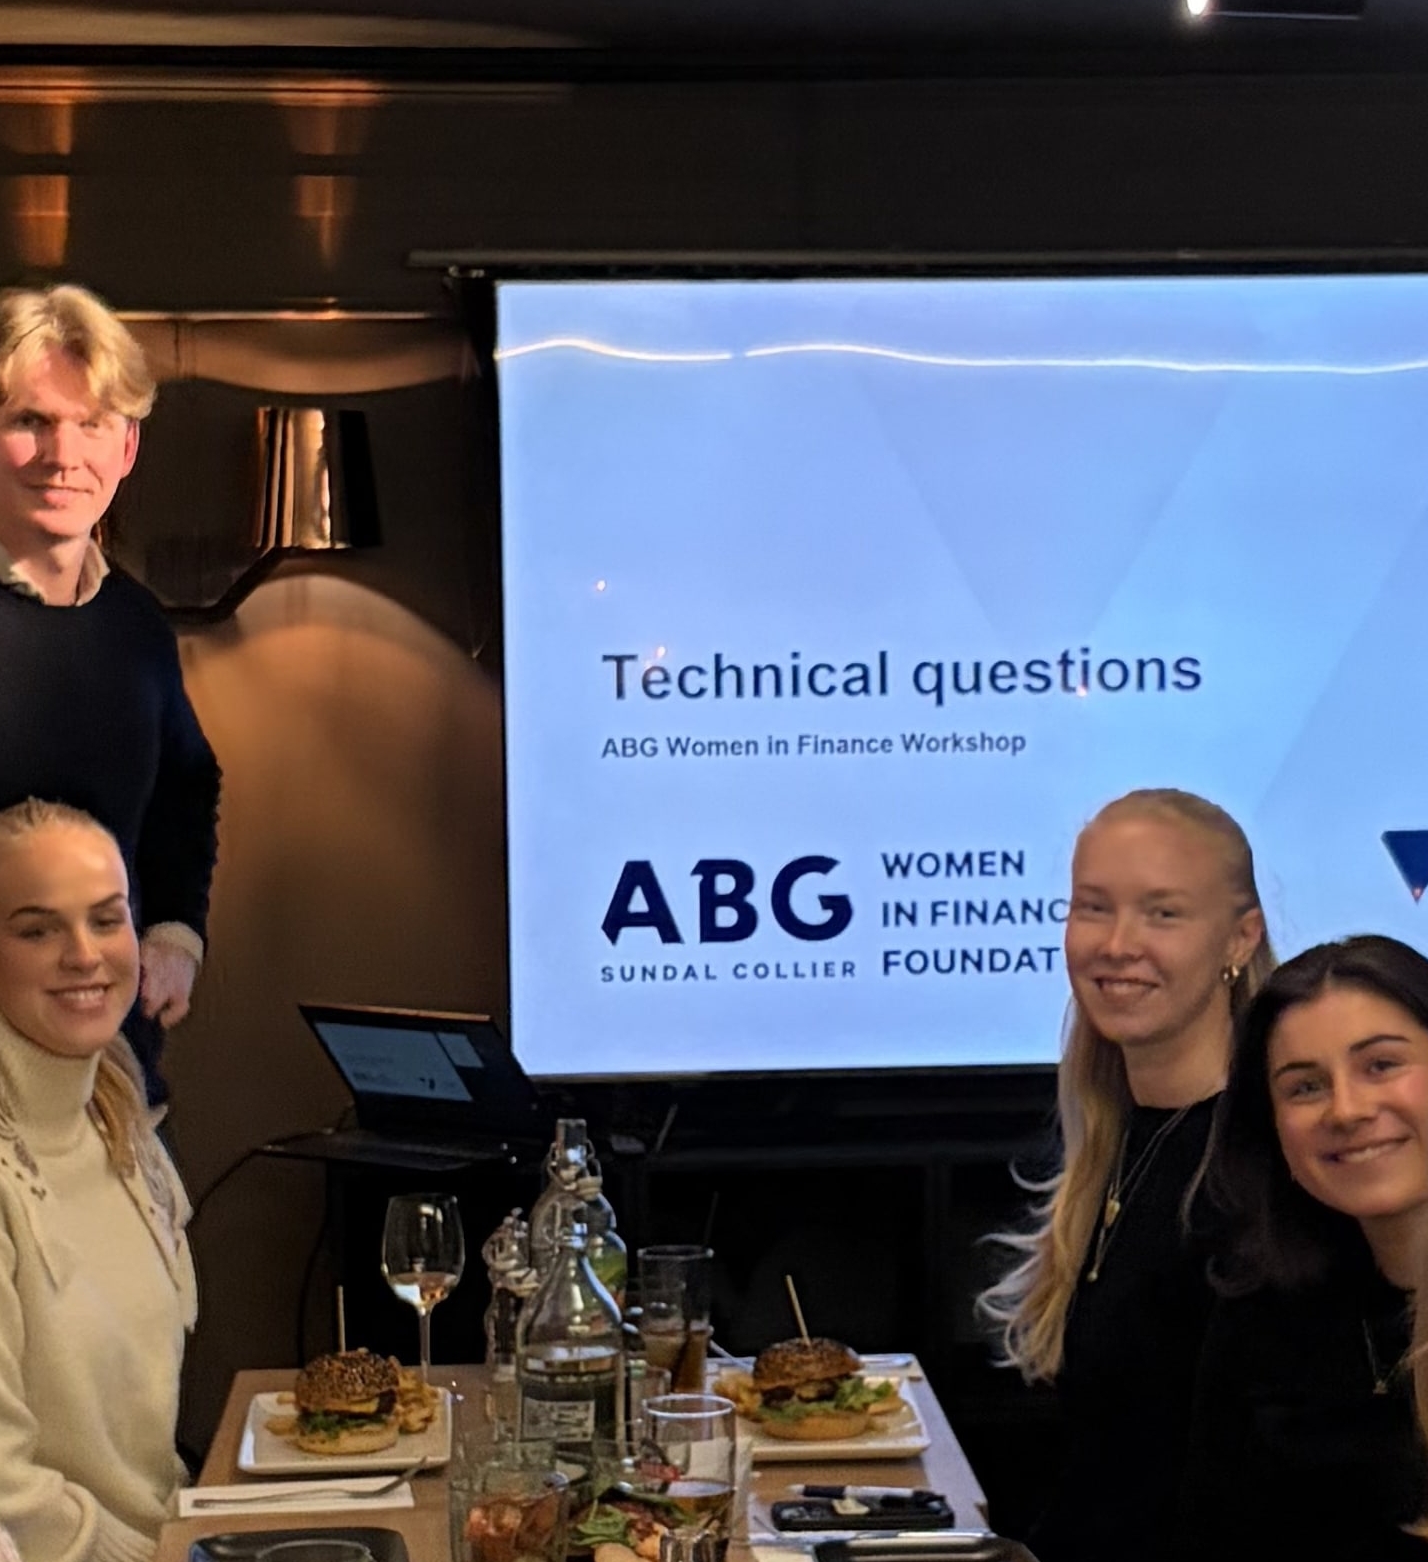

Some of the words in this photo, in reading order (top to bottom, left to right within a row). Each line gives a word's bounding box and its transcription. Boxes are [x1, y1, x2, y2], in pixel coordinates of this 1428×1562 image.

[601, 650, 889, 700] Technical
[912, 647, 1203, 706] questions
[601, 736, 659, 759] ABG
[666, 736, 759, 758] Women
[767, 734, 789, 756] in
[797, 734, 894, 756] Finance
[900, 731, 1027, 757] Workshop
[880, 849, 1025, 880] WOMEN
[600, 855, 855, 947] ABG
[881, 900, 918, 928] IN
[929, 897, 1070, 928] FINANC
[600, 963, 718, 983] SUNDAL
[732, 960, 856, 981] COLLIER
[882, 946, 1061, 977] FOUNDAT
